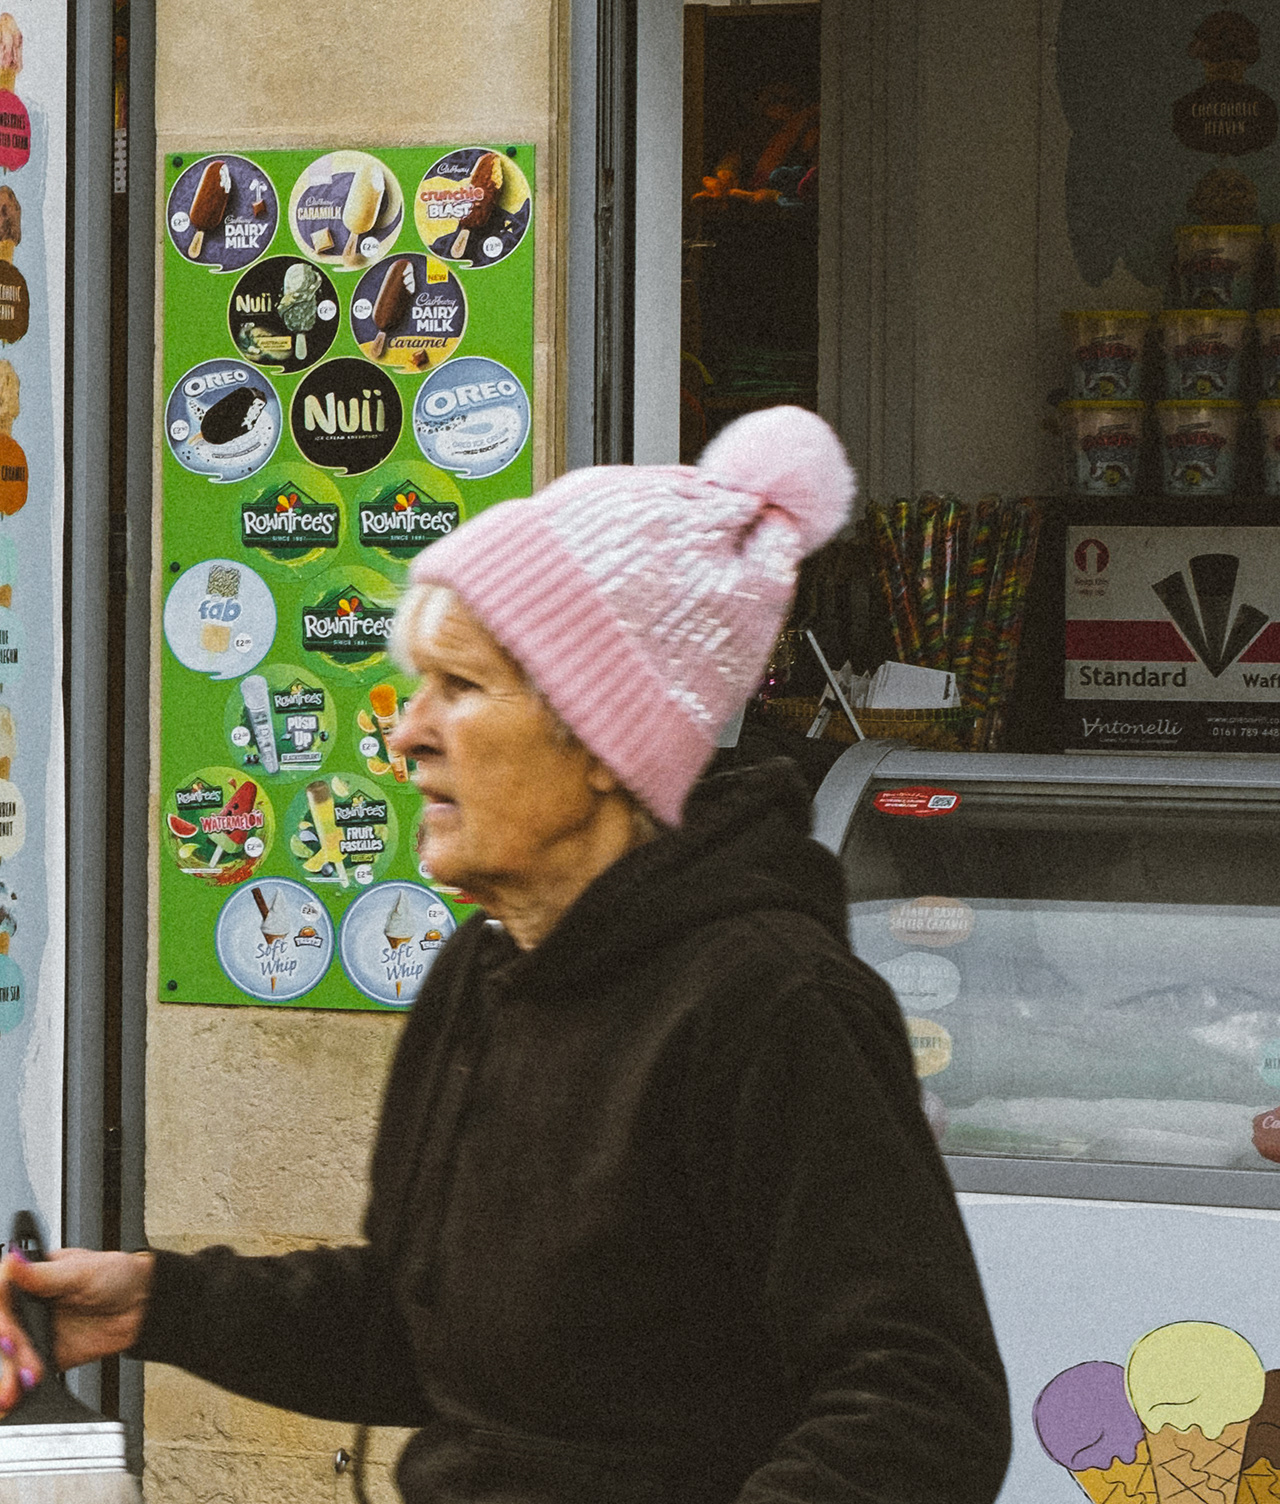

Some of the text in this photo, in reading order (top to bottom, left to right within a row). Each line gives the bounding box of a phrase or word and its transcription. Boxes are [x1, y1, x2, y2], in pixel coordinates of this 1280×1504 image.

[437, 163, 470, 175] Cadbury
[420, 187, 484, 202] crunchie
[298, 206, 342, 220] CARAMILK
[428, 203, 473, 219] BLAST
[225, 224, 268, 237] DAIRY
[225, 236, 260, 249] MILK
[235, 292, 272, 313] Nuii
[412, 306, 459, 320] DAIRY
[417, 320, 454, 333] MILK
[388, 336, 448, 349] Caramel
[184, 369, 248, 397] OREO
[423, 380, 517, 417] OREO
[304, 389, 386, 434] Nuii
[243, 508, 336, 534] Rowntree's
[361, 507, 454, 535] Rowntree's
[198, 599, 242, 622] fab
[1080, 666, 1187, 688] Standard
[287, 716, 317, 730] PUSH
[294, 730, 312, 747] UP
[200, 810, 264, 834] WATERMELON
[255, 939, 288, 959] Soft
[380, 943, 414, 964] Soft
[261, 959, 297, 977] Whip
[386, 963, 423, 981] Whip
